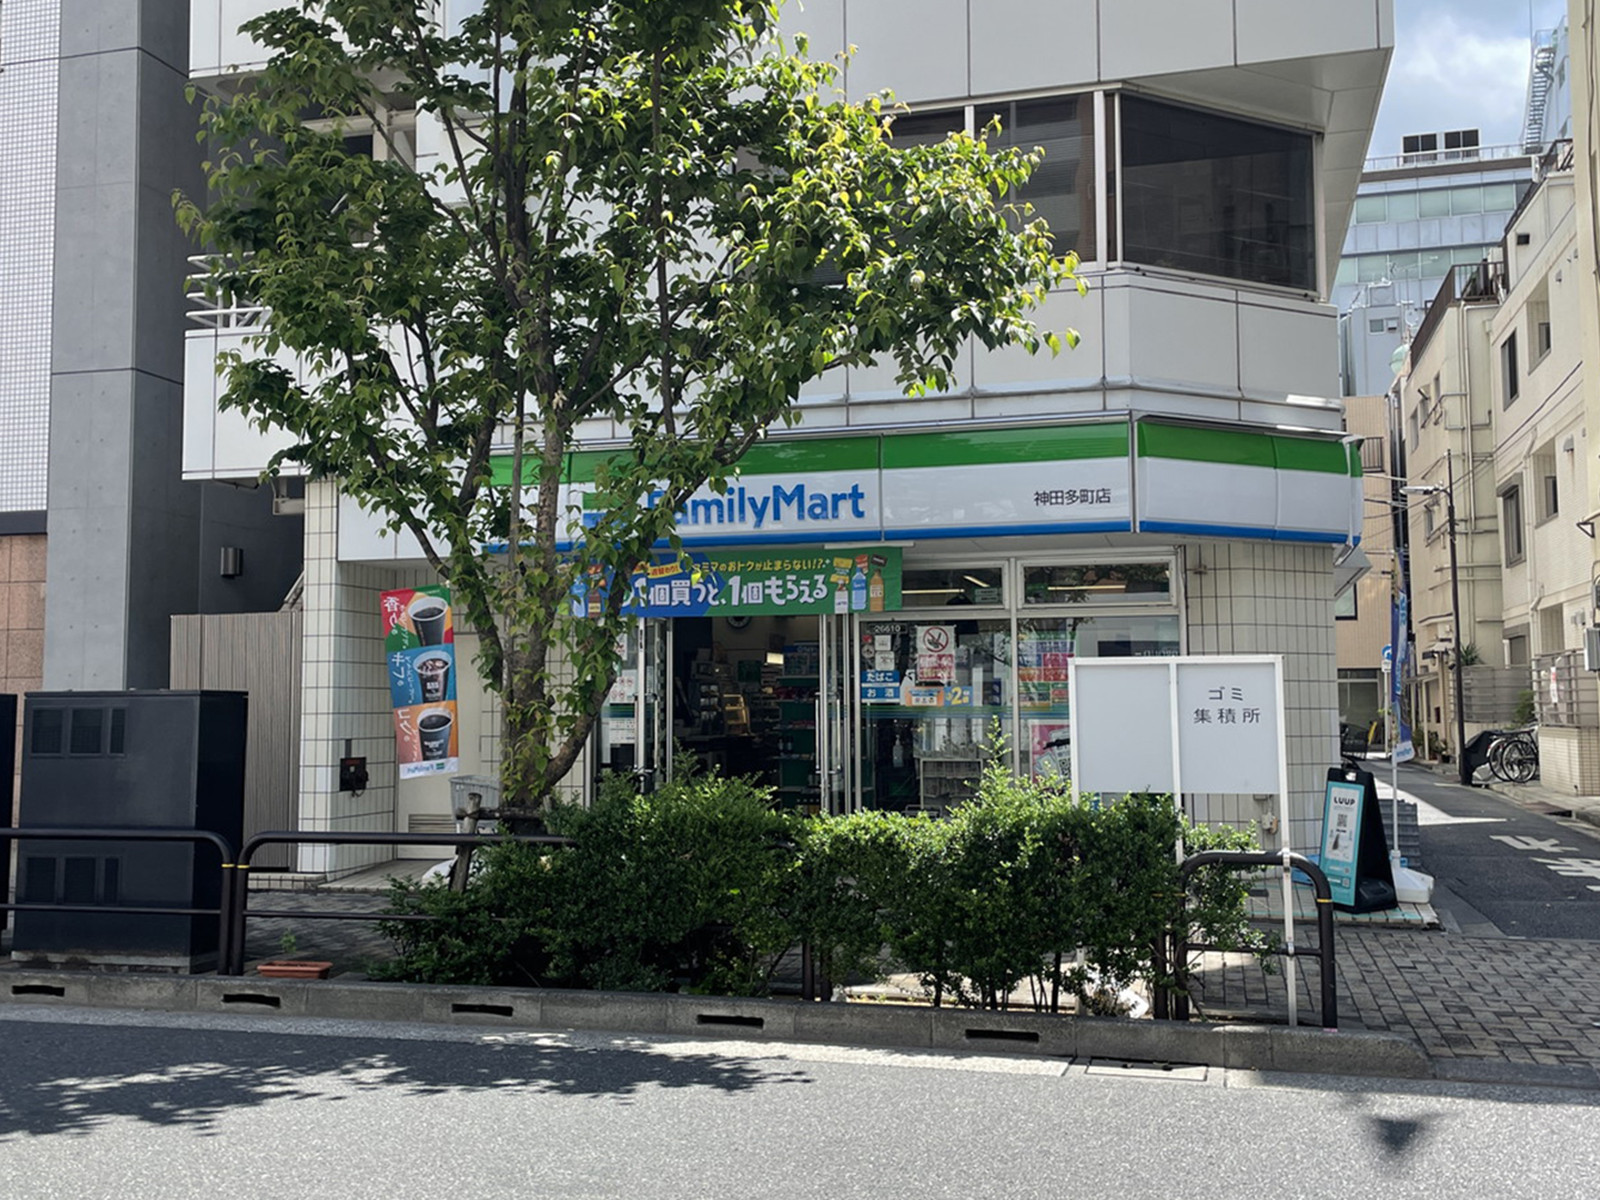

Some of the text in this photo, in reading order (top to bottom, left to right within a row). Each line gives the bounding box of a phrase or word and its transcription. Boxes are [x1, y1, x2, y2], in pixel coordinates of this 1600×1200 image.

[1034, 488, 1111, 506] 神田多町店
[691, 558, 824, 573] ァミマのおトクが止まらない!?
[1209, 686, 1243, 701] ゴミ
[1194, 708, 1260, 724] 集積所
[1333, 796, 1356, 806] LUUP
